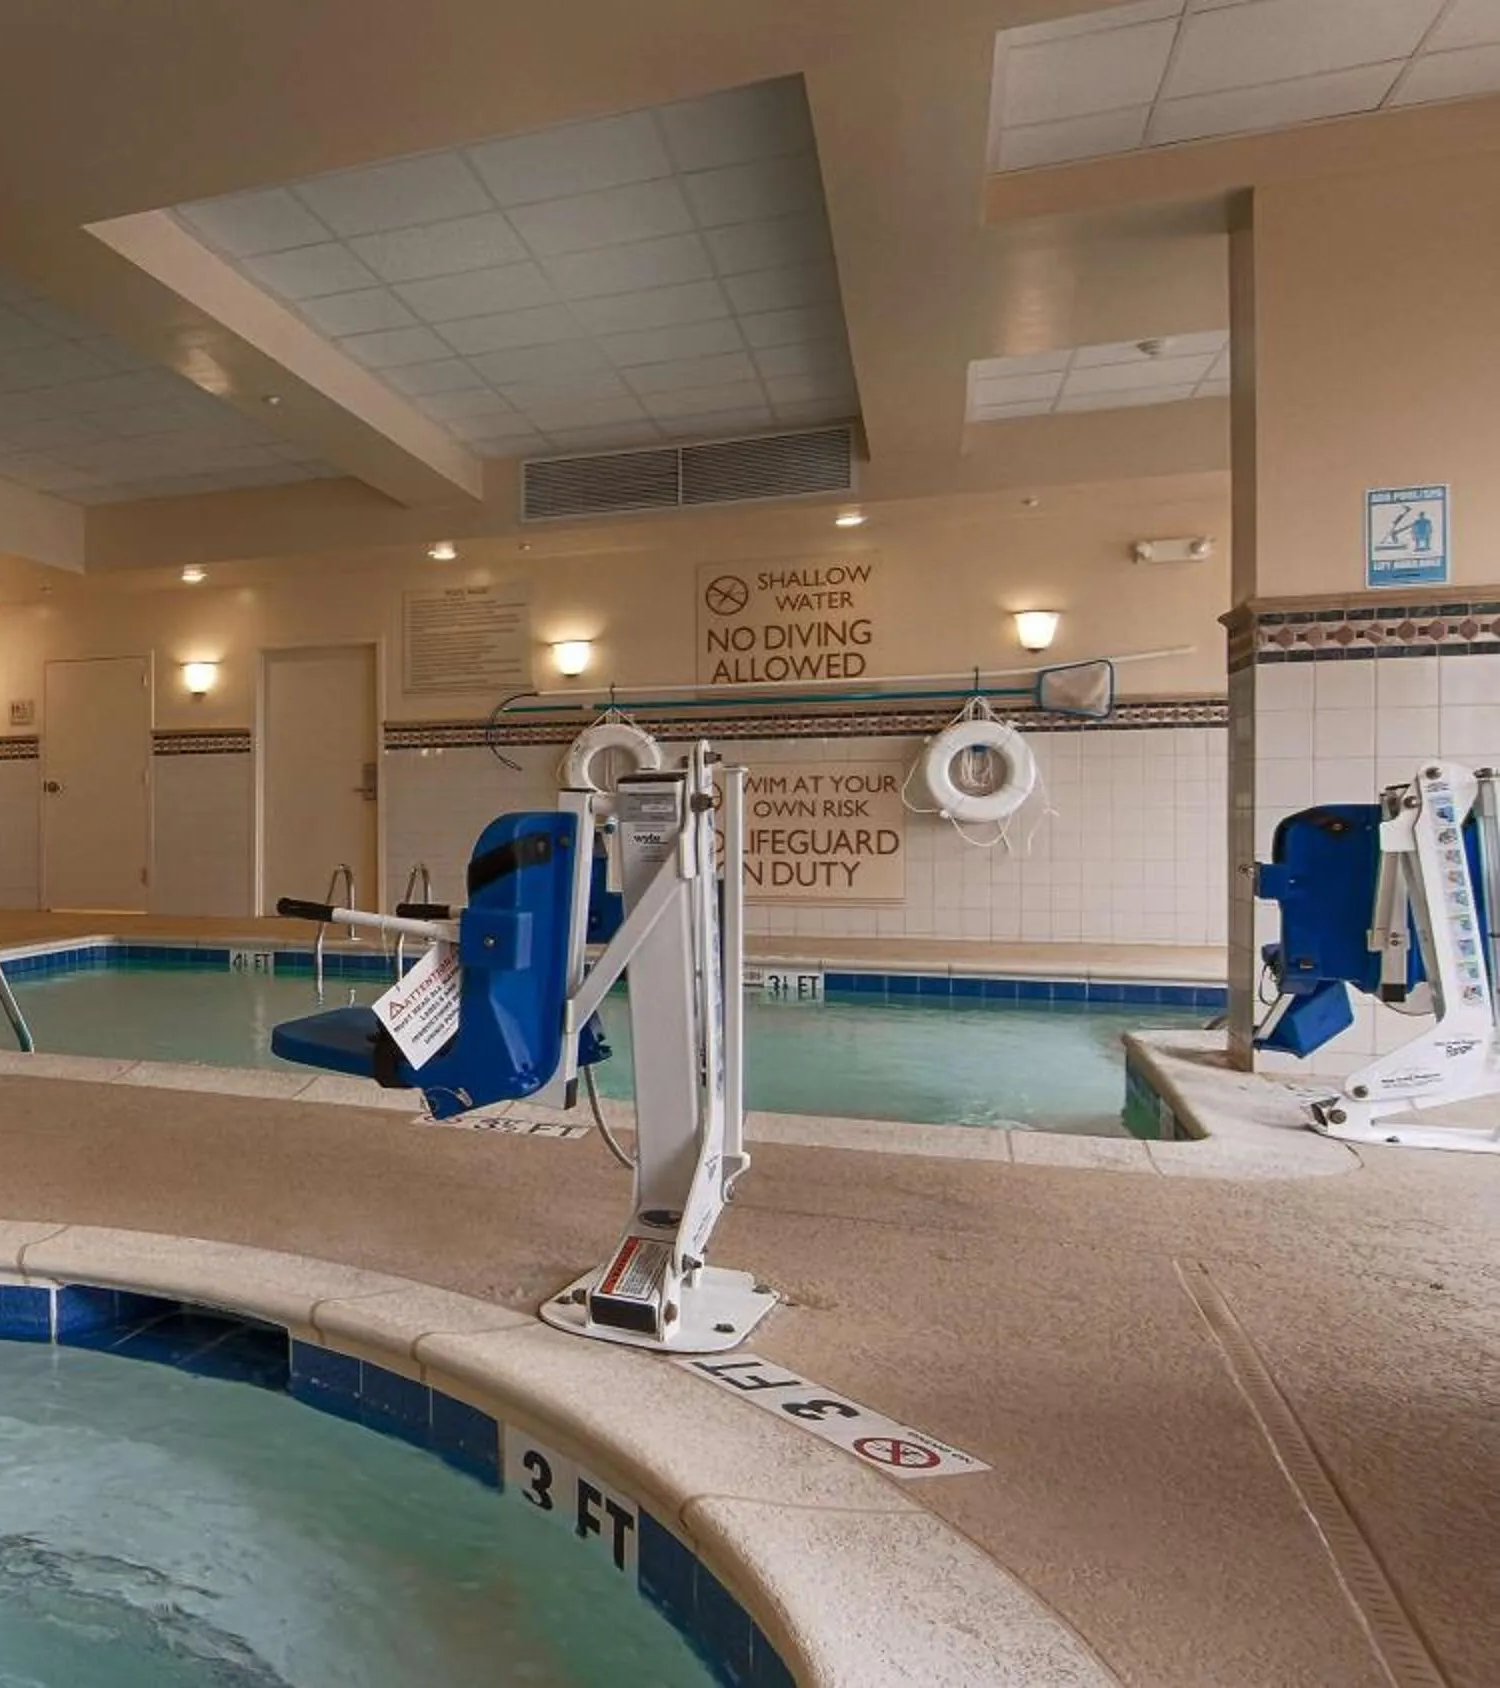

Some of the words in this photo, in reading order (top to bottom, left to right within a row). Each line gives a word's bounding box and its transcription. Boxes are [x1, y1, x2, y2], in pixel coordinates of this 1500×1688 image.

[757, 565, 871, 591] SHALLOW
[775, 591, 854, 612] WATER
[707, 625, 756, 653] NO
[764, 619, 872, 651] DIVING
[711, 652, 866, 685] ALLOWED
[743, 776, 787, 794] WIM
[792, 776, 824, 796] AT
[828, 775, 898, 794] YOUR
[753, 800, 816, 819] OWN
[823, 799, 870, 818] RISK
[771, 861, 861, 887] DUTY
[529, 1122, 585, 1137] FT
[690, 1361, 802, 1390] FT
[781, 1399, 860, 1421] 3
[522, 1450, 553, 1512] 3
[575, 1476, 635, 1572] FT
